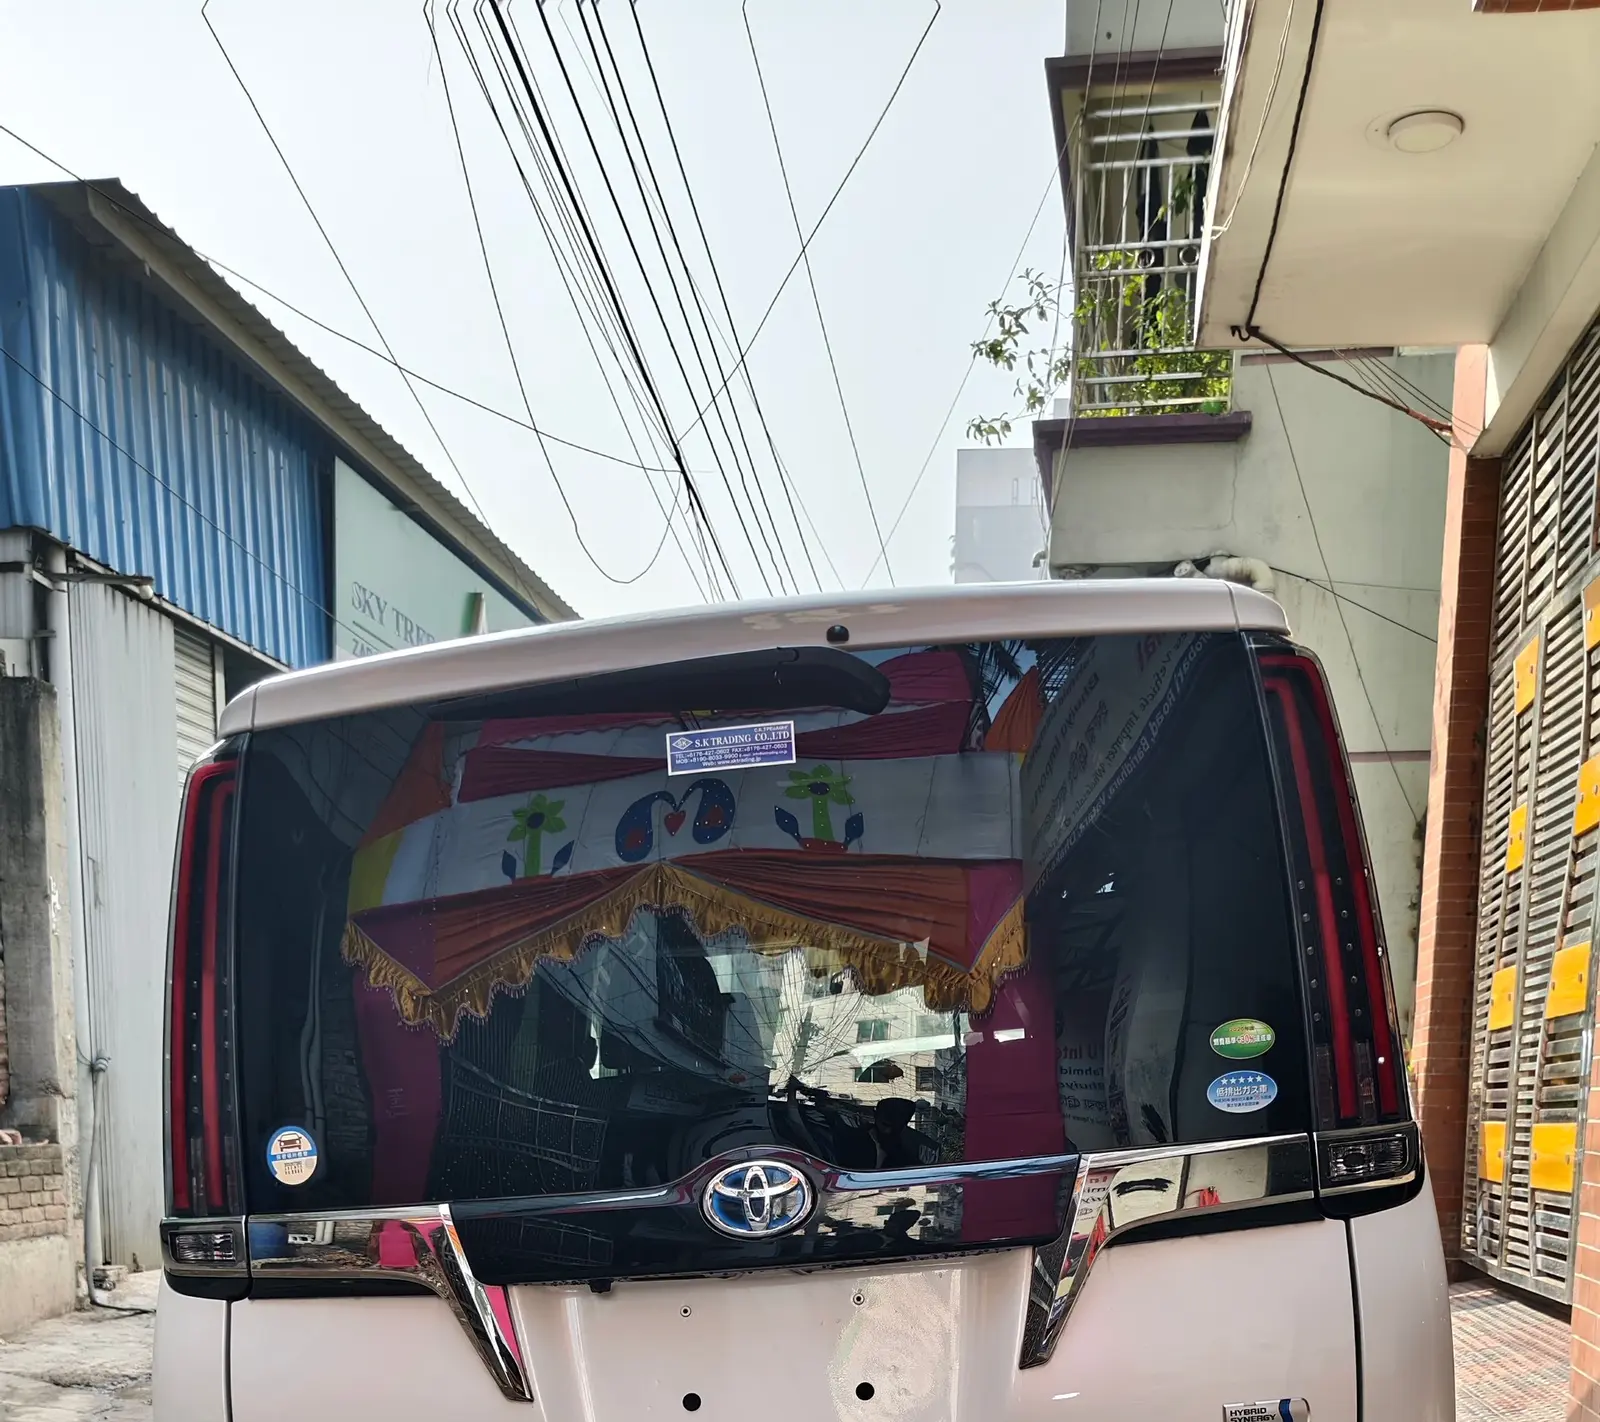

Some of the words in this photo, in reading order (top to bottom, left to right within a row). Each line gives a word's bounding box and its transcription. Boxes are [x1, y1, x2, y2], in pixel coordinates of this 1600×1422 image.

[352, 581, 388, 627] SKY
[710, 734, 751, 746] TRADING
[754, 731, 790, 741] CO.,LTD
[1229, 1407, 1267, 1417] HYBRID
